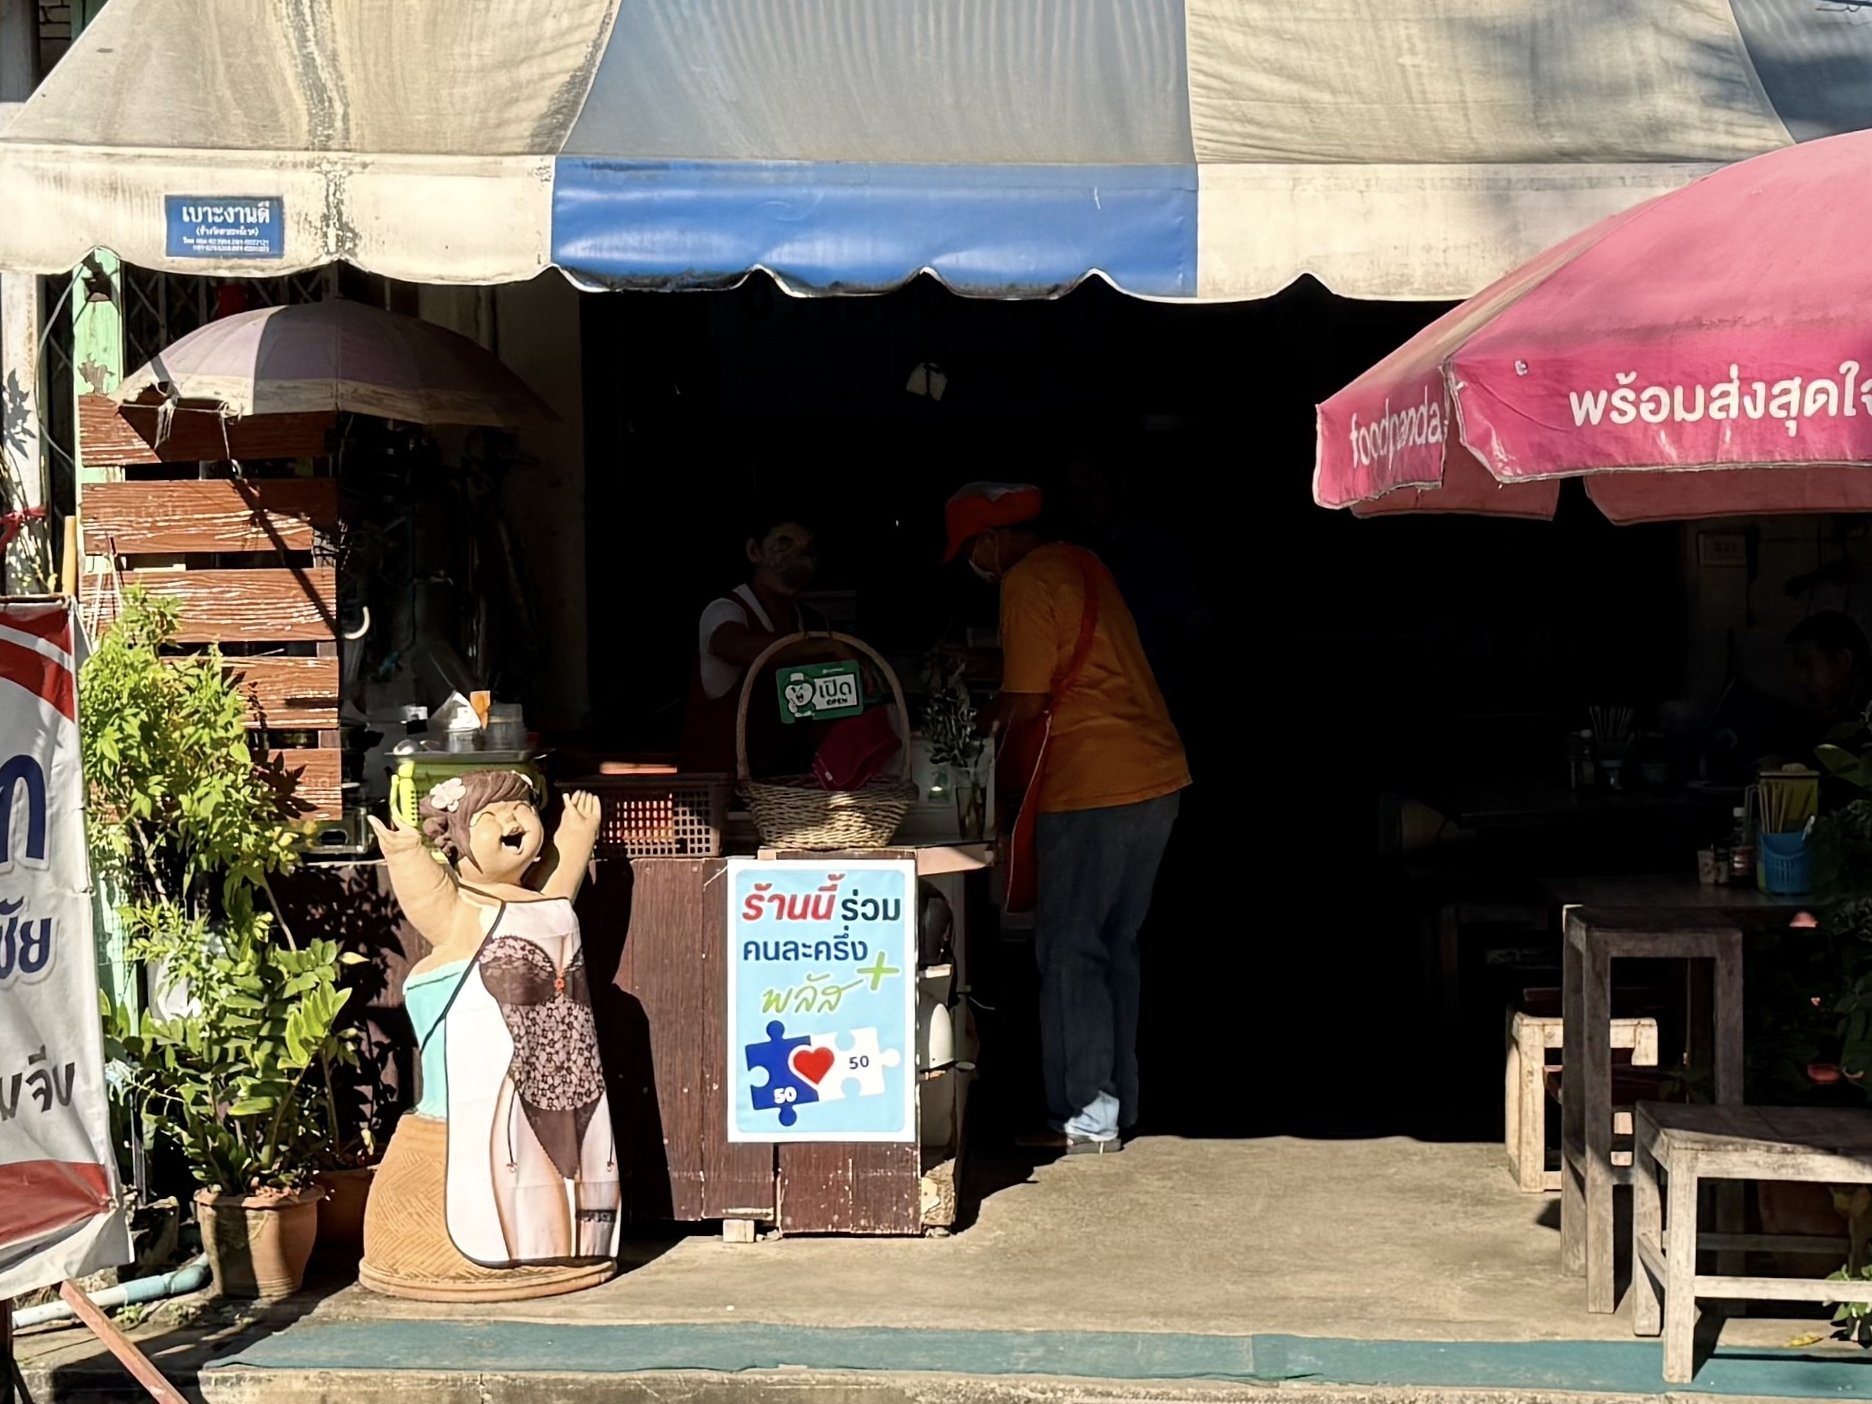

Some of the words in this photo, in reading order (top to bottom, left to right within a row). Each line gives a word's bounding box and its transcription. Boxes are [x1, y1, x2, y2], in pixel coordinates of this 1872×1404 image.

[1349, 384, 1443, 469] foodpanda
[819, 679, 852, 698] เปิด
[742, 873, 846, 921] ร้านนี้
[841, 888, 901, 921] ร่วม
[743, 925, 868, 962] คนละครึ่ง
[762, 973, 864, 1014] พลัส
[848, 1054, 870, 1070] 50
[773, 1086, 798, 1104] 50
